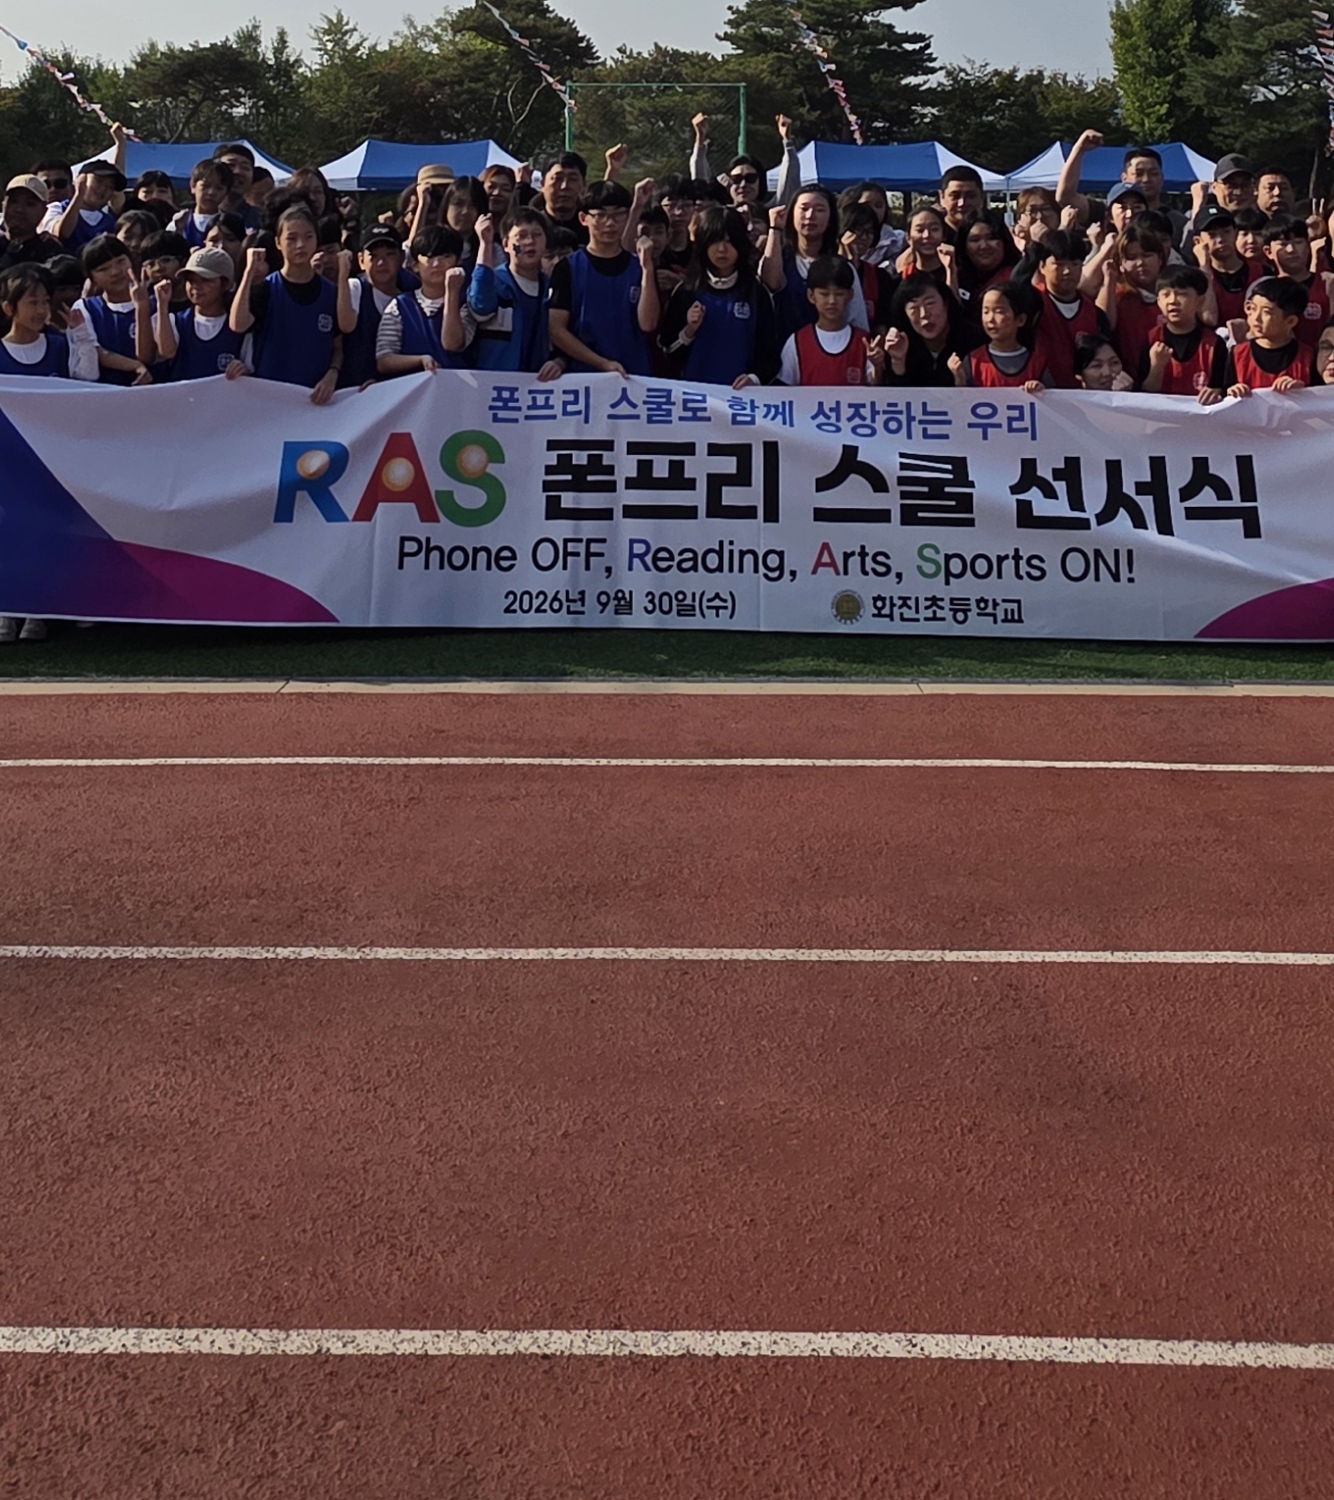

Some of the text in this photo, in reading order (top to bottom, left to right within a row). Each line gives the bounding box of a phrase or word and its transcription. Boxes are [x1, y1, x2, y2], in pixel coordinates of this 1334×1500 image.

[487, 385, 1038, 441] 폰프리 스쿨로 함께 성장하는 우리
[272, 429, 507, 528] RAS
[541, 438, 1263, 540] 폰프리 스쿨 선서식
[397, 535, 1136, 586] Phone OFF, Reading, Arts, Sports ON!
[503, 588, 737, 620] 2026년 9월 30일(수)
[871, 593, 1025, 626] 화진초등학교
